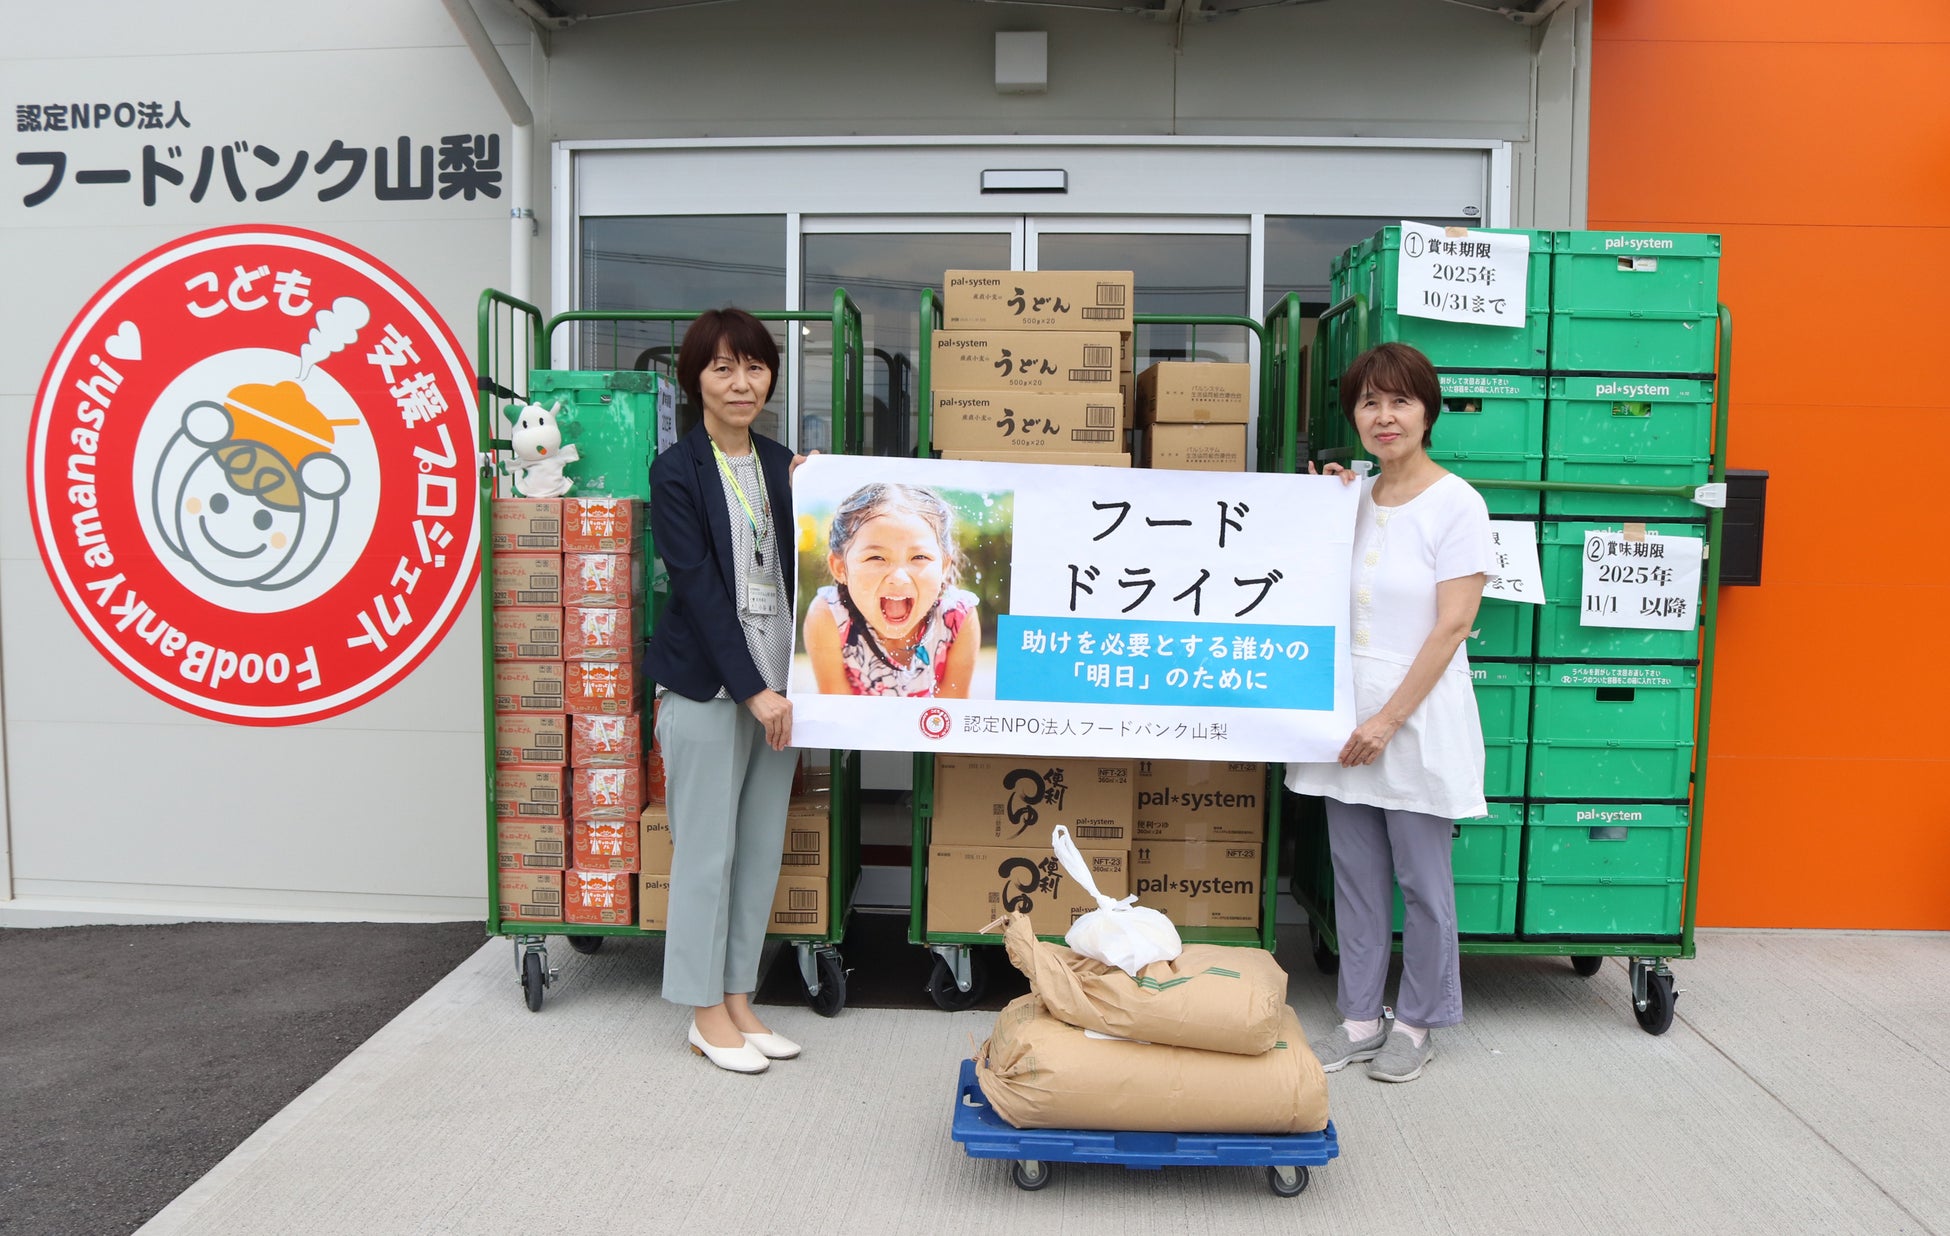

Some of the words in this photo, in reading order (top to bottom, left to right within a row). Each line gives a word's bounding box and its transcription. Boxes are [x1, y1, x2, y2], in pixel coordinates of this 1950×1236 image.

[16, 101, 191, 132] 認定NPO法人
[16, 133, 502, 207] フードバンク山梨
[1428, 238, 1491, 259] 賞味期限
[1432, 263, 1496, 286] 2025年
[1007, 286, 1070, 315] うどん
[1423, 290, 1507, 314] 10/31まで
[994, 348, 1058, 377] うどん
[996, 408, 1060, 437] うどん
[184, 264, 313, 318] こども
[347, 322, 457, 652] 支援プロジェクト
[1092, 500, 1250, 548] フード
[1607, 541, 1665, 558] 賞味期限
[1598, 564, 1674, 587] 2025年
[1068, 564, 1284, 617] ドライブ
[1586, 594, 1618, 616] 11/1
[1640, 596, 1687, 618] 以降
[1021, 629, 1309, 661] 助けを必要とする誰かの
[1074, 662, 1268, 690] 「明日」のために
[963, 715, 1229, 741] 認定NPO法人フードバンク山梨
[1003, 768, 1047, 840] つゆ
[1093, 858, 1122, 866] NFT-23
